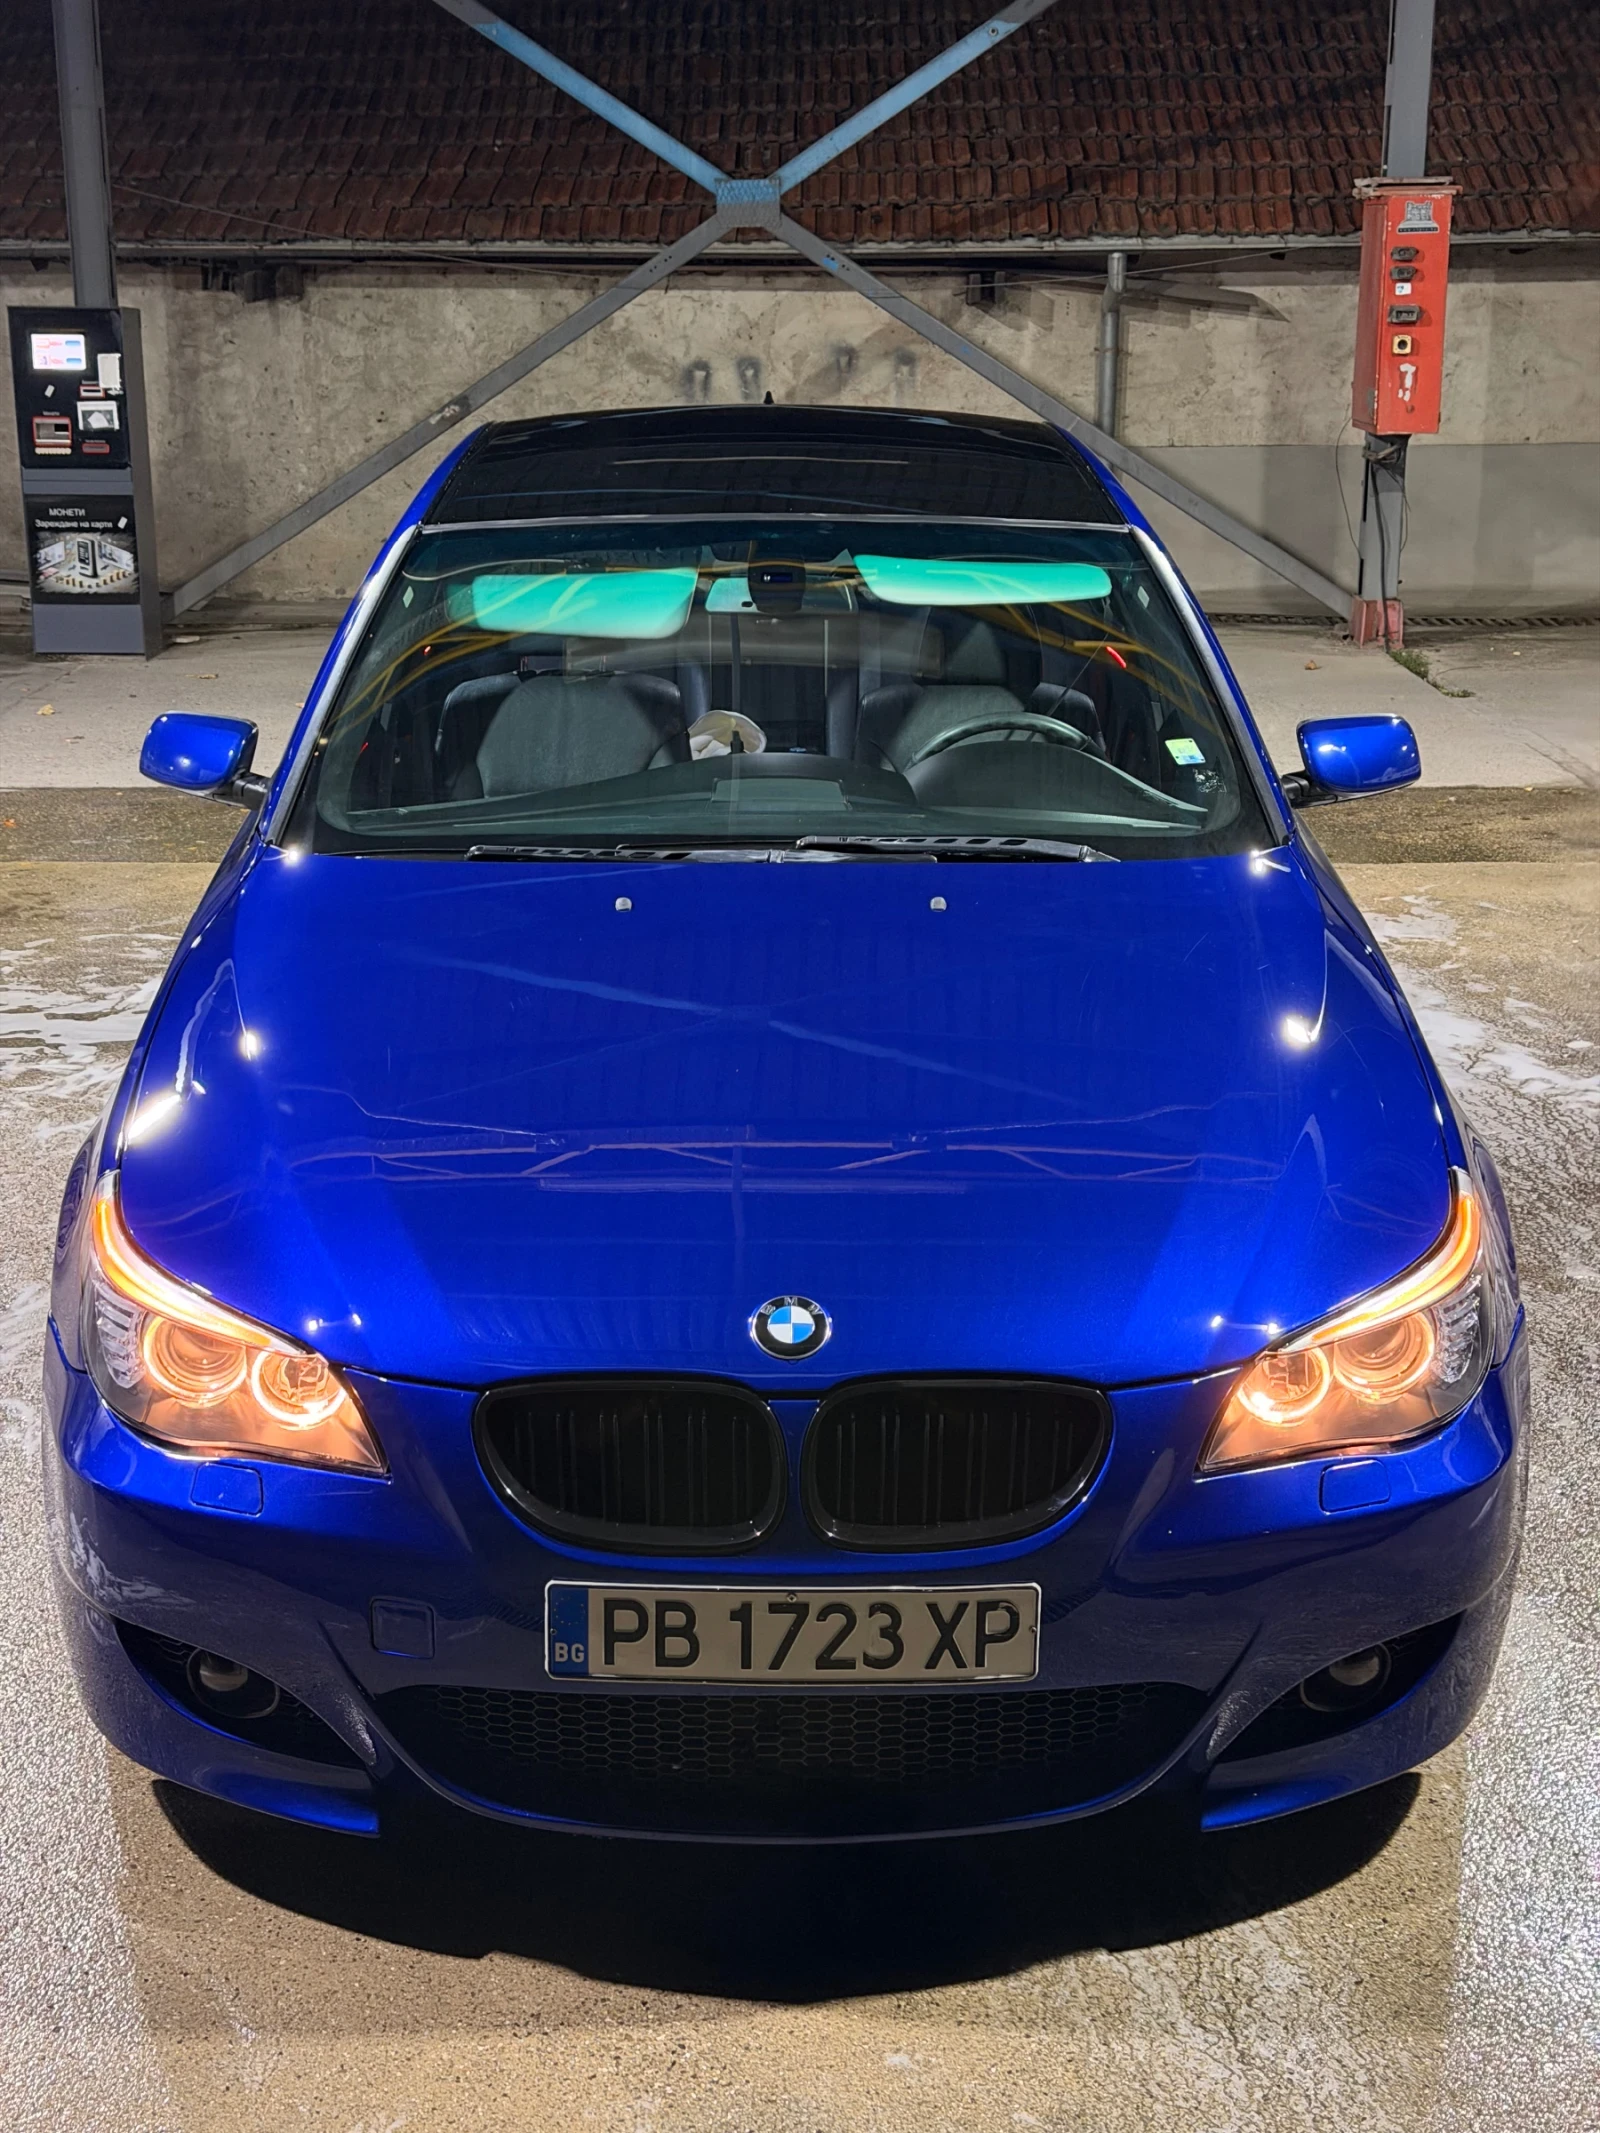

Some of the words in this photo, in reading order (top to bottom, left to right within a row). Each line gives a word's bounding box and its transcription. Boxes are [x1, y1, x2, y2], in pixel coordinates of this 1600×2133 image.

[48, 507, 86, 517] МОНЕТИ
[34, 518, 79, 529] Зареждане
[760, 1296, 824, 1316] BMW
[603, 1597, 701, 1669] PB
[729, 1602, 905, 1671] 1723
[923, 1599, 1021, 1670] XP
[554, 1642, 585, 1663] BG
